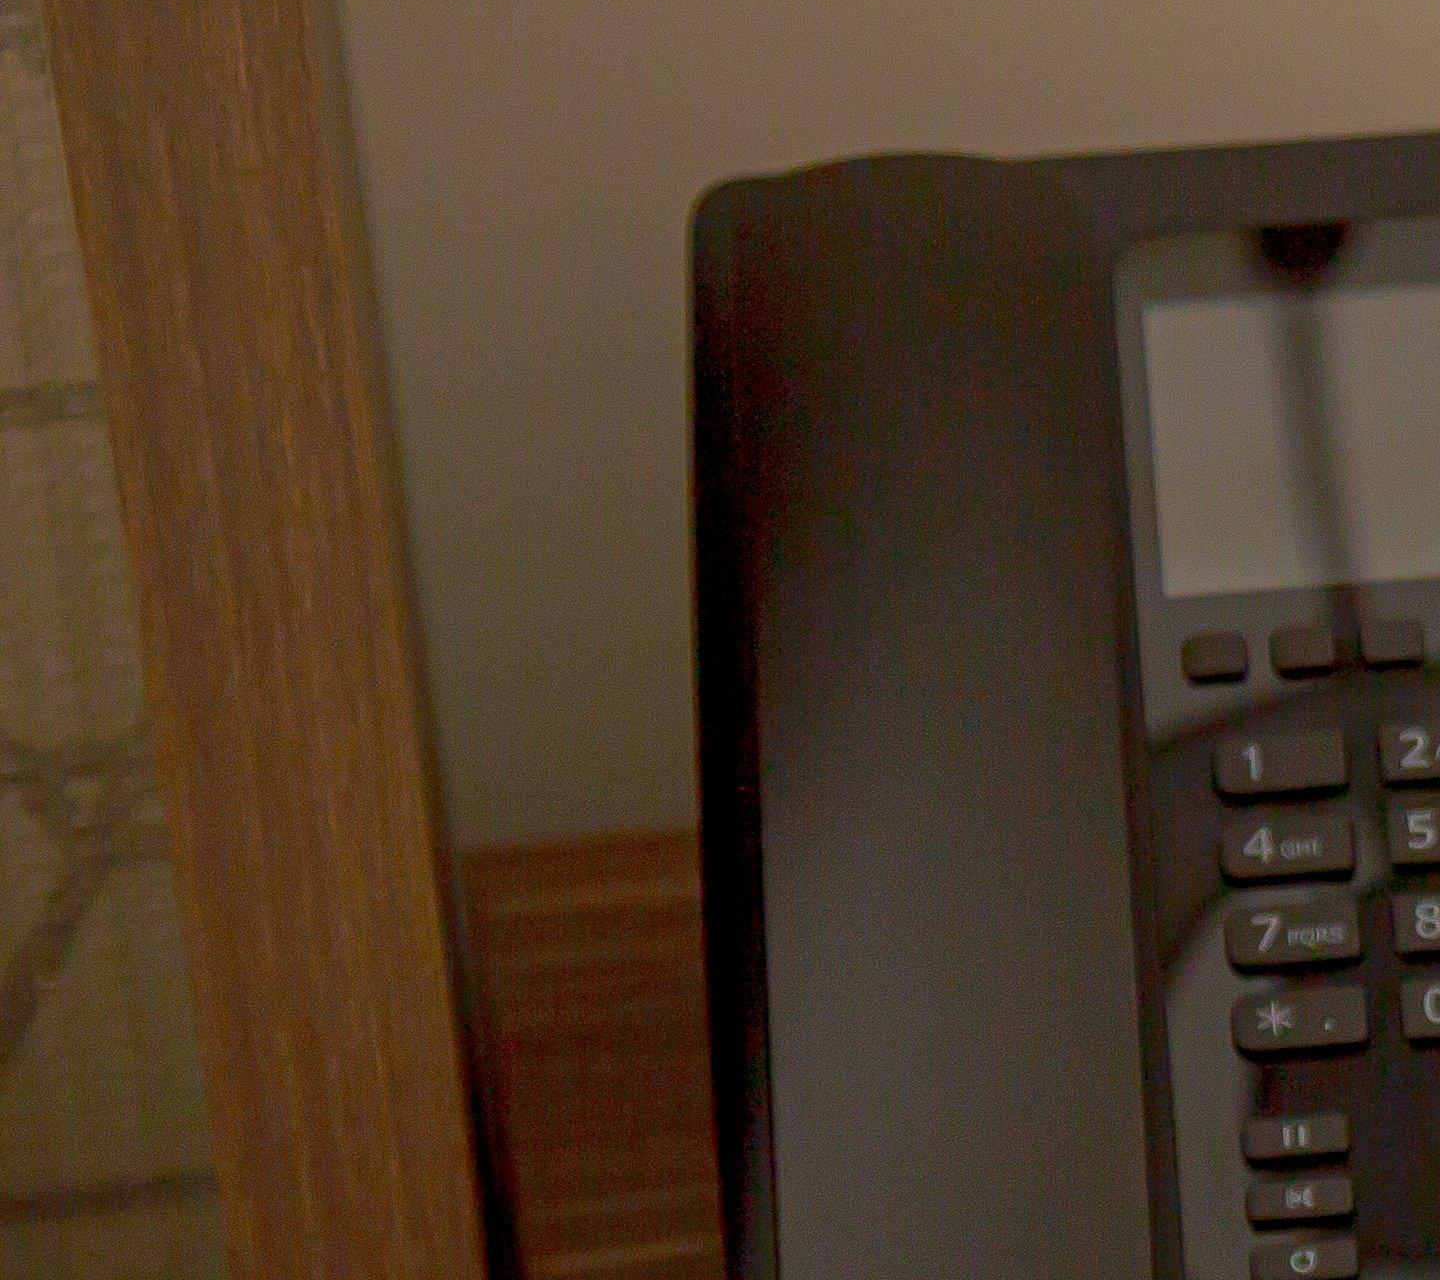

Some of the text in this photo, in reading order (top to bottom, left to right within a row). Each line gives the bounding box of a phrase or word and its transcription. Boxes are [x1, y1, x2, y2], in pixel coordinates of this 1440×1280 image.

[1241, 743, 1262, 780] 1
[1400, 725, 1429, 769] 2
[1243, 824, 1271, 862] 4
[1407, 809, 1434, 849] 5
[1253, 912, 1281, 951] 7
